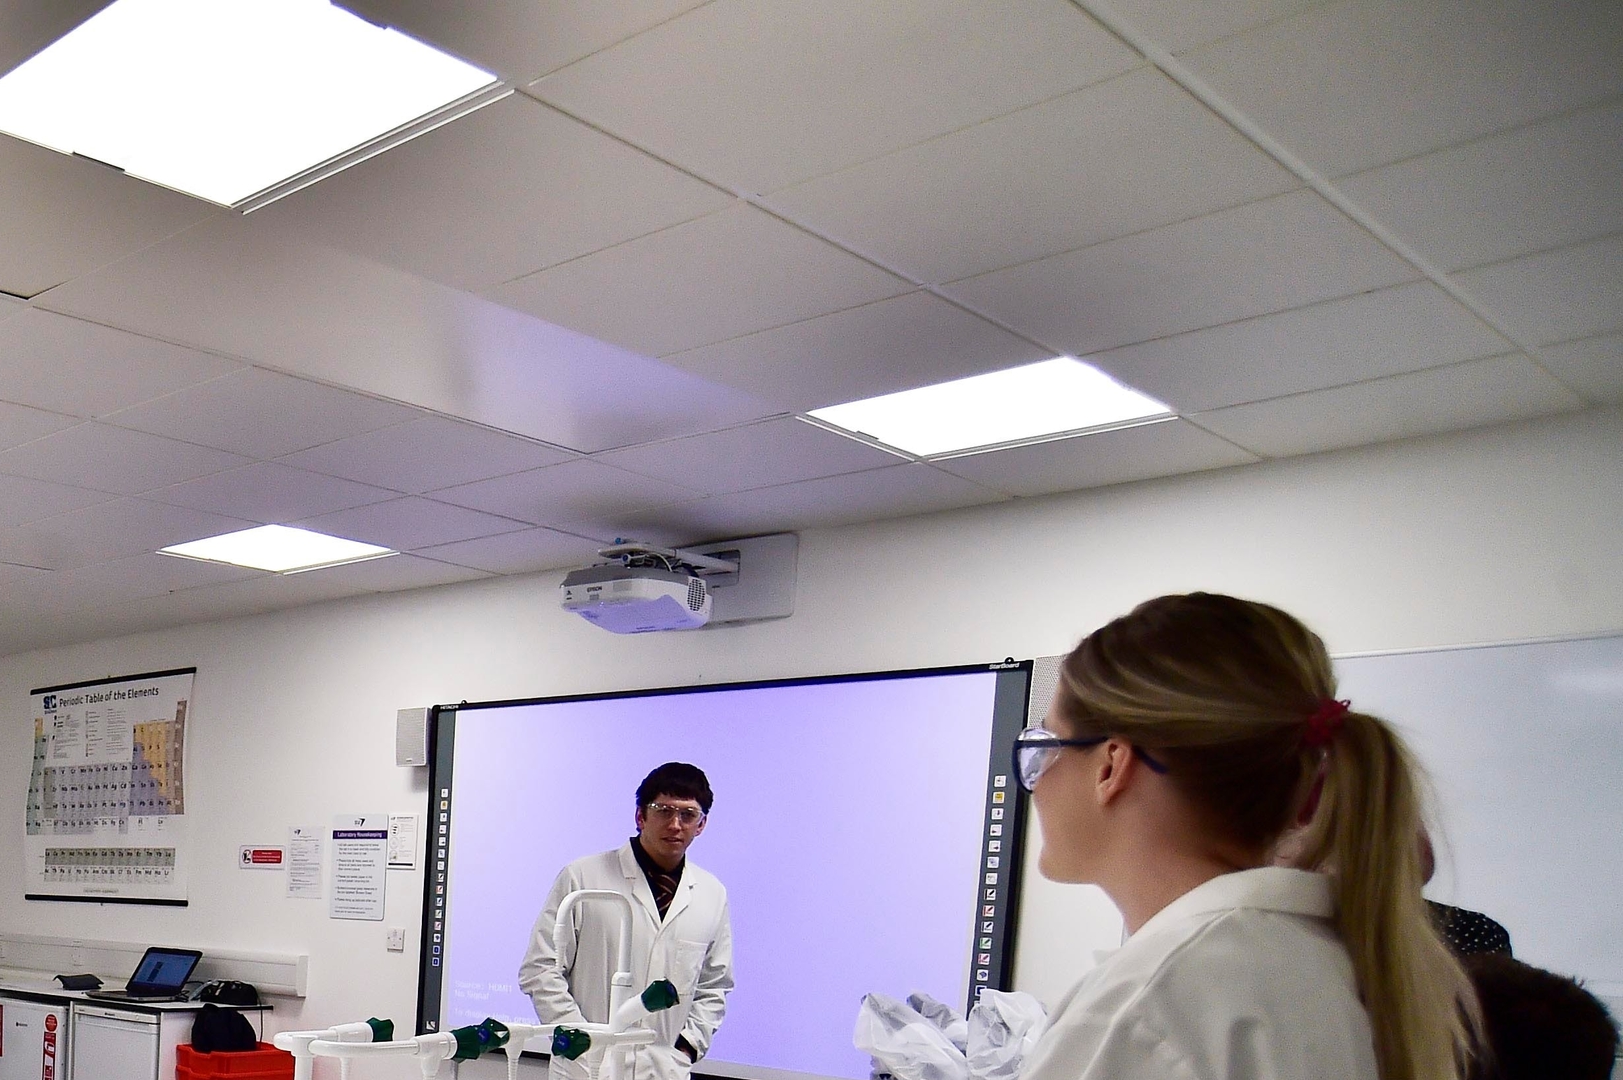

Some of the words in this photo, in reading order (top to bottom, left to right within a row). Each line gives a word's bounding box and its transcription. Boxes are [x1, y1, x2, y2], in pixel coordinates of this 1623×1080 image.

[59, 696, 83, 708] Periodic
[85, 692, 103, 704] Table
[105, 691, 113, 701] of
[114, 689, 126, 700] the
[128, 687, 159, 699] Elements
[467, 991, 489, 1000] Signal
